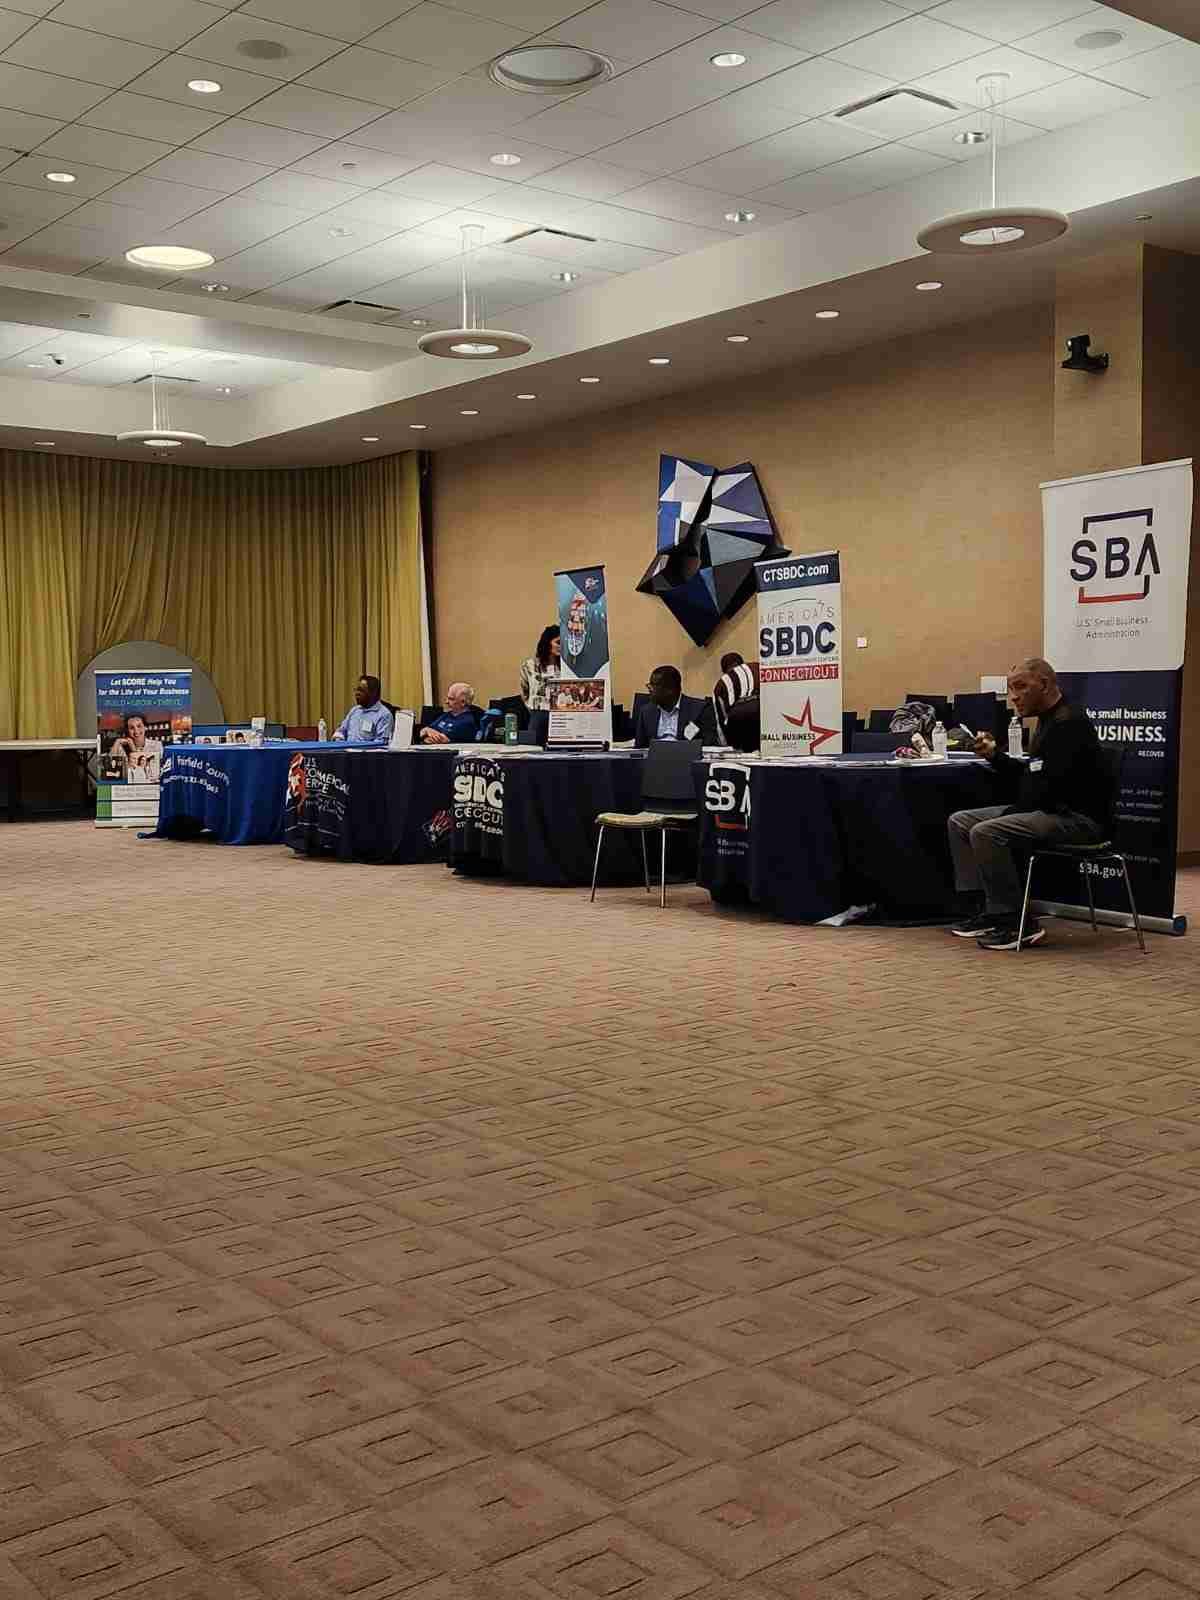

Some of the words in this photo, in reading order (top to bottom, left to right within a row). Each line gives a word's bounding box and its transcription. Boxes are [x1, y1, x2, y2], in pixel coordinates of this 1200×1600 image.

[1070, 533, 1160, 582] SBA
[763, 564, 829, 583] CTSBDC.com
[760, 621, 836, 658] SBDC
[121, 678, 146, 686] SCORE
[760, 666, 838, 681] CONNECTICUT
[1098, 708, 1122, 719] small
[1124, 707, 1167, 720] business
[1094, 725, 1166, 743] USINESS.
[705, 780, 751, 816] SBA
